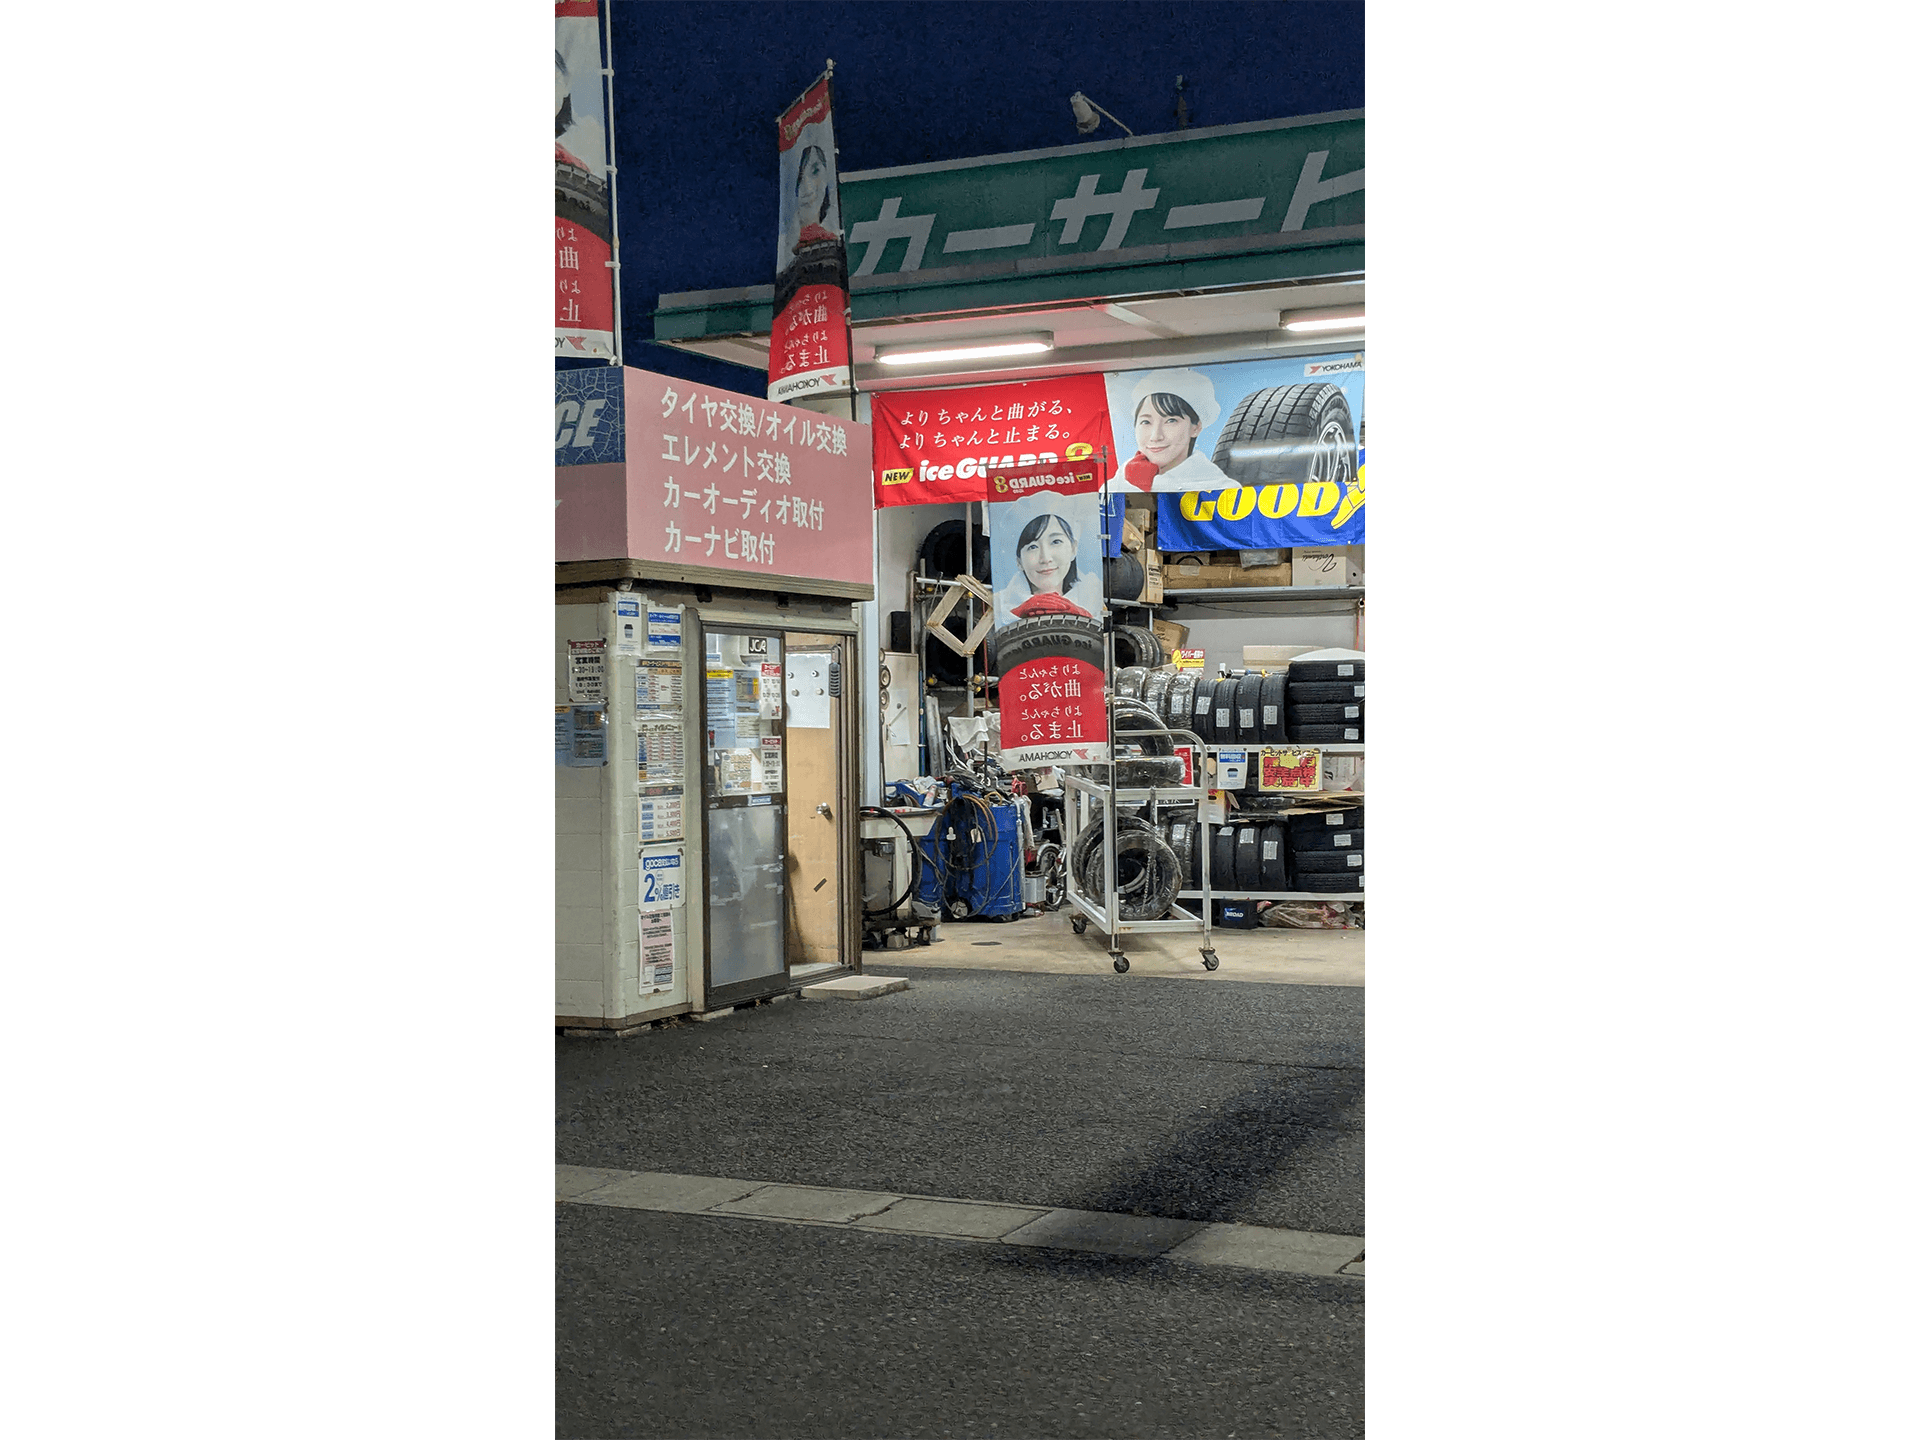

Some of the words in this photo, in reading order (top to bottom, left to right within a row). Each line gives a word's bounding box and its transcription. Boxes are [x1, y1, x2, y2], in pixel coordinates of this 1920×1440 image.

[1321, 361, 1363, 372] YOKOHAMA
[661, 386, 848, 457] タイヤ交換/オイル交換
[661, 434, 792, 486] エレメント交換
[884, 471, 911, 483] NEW
[663, 476, 825, 531] カーオーディオ取付
[664, 521, 776, 565] カーナビ取付
